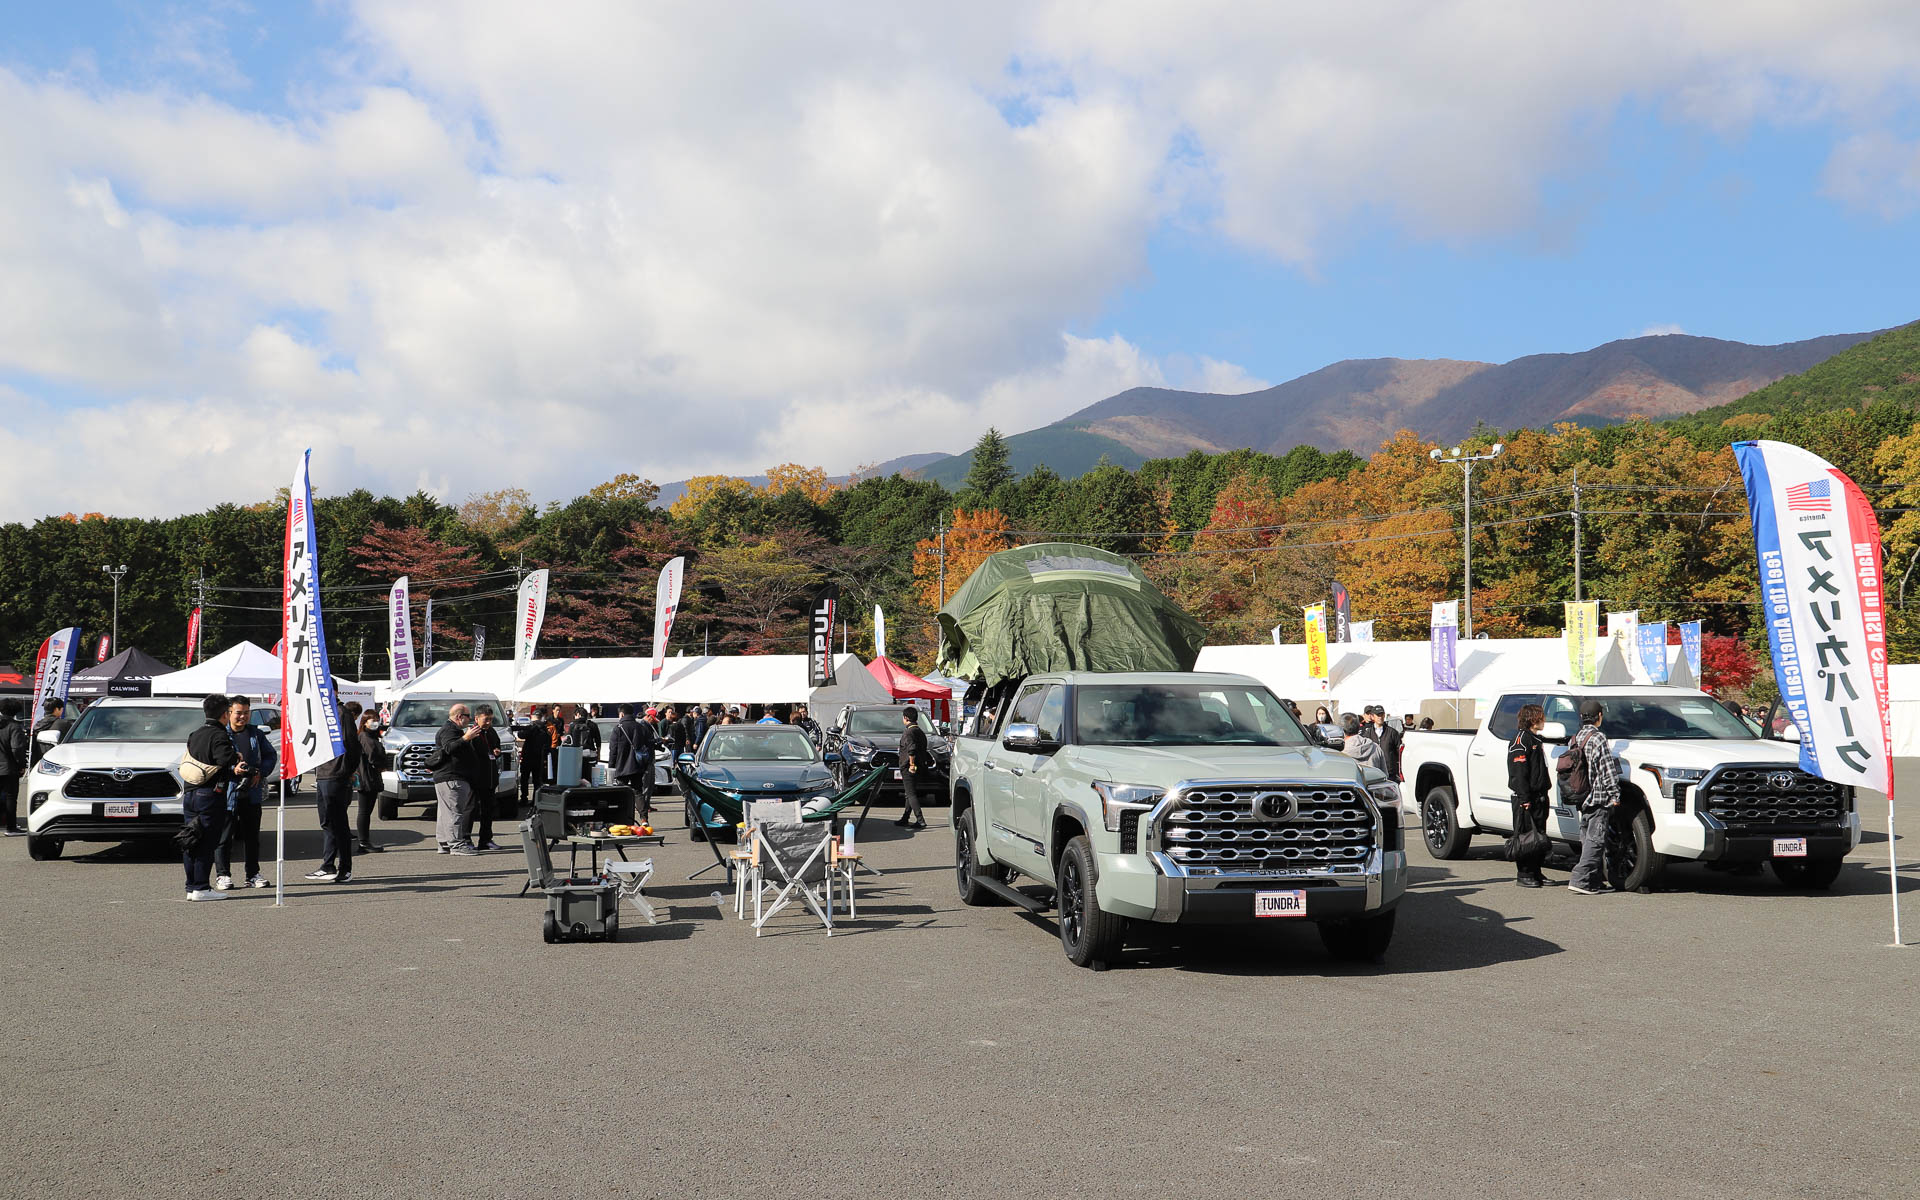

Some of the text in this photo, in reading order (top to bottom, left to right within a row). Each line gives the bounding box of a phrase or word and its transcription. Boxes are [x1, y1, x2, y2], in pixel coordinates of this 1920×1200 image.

[394, 588, 411, 681] apr racing
[814, 599, 829, 680] IMPUL
[1308, 622, 1321, 676] ふじおやま
[44, 654, 62, 698] アメリカ
[308, 614, 325, 685] American
[319, 688, 341, 742] Power!!
[1777, 843, 1803, 853] TUNDRA
[1261, 896, 1300, 911] TUNDRA
